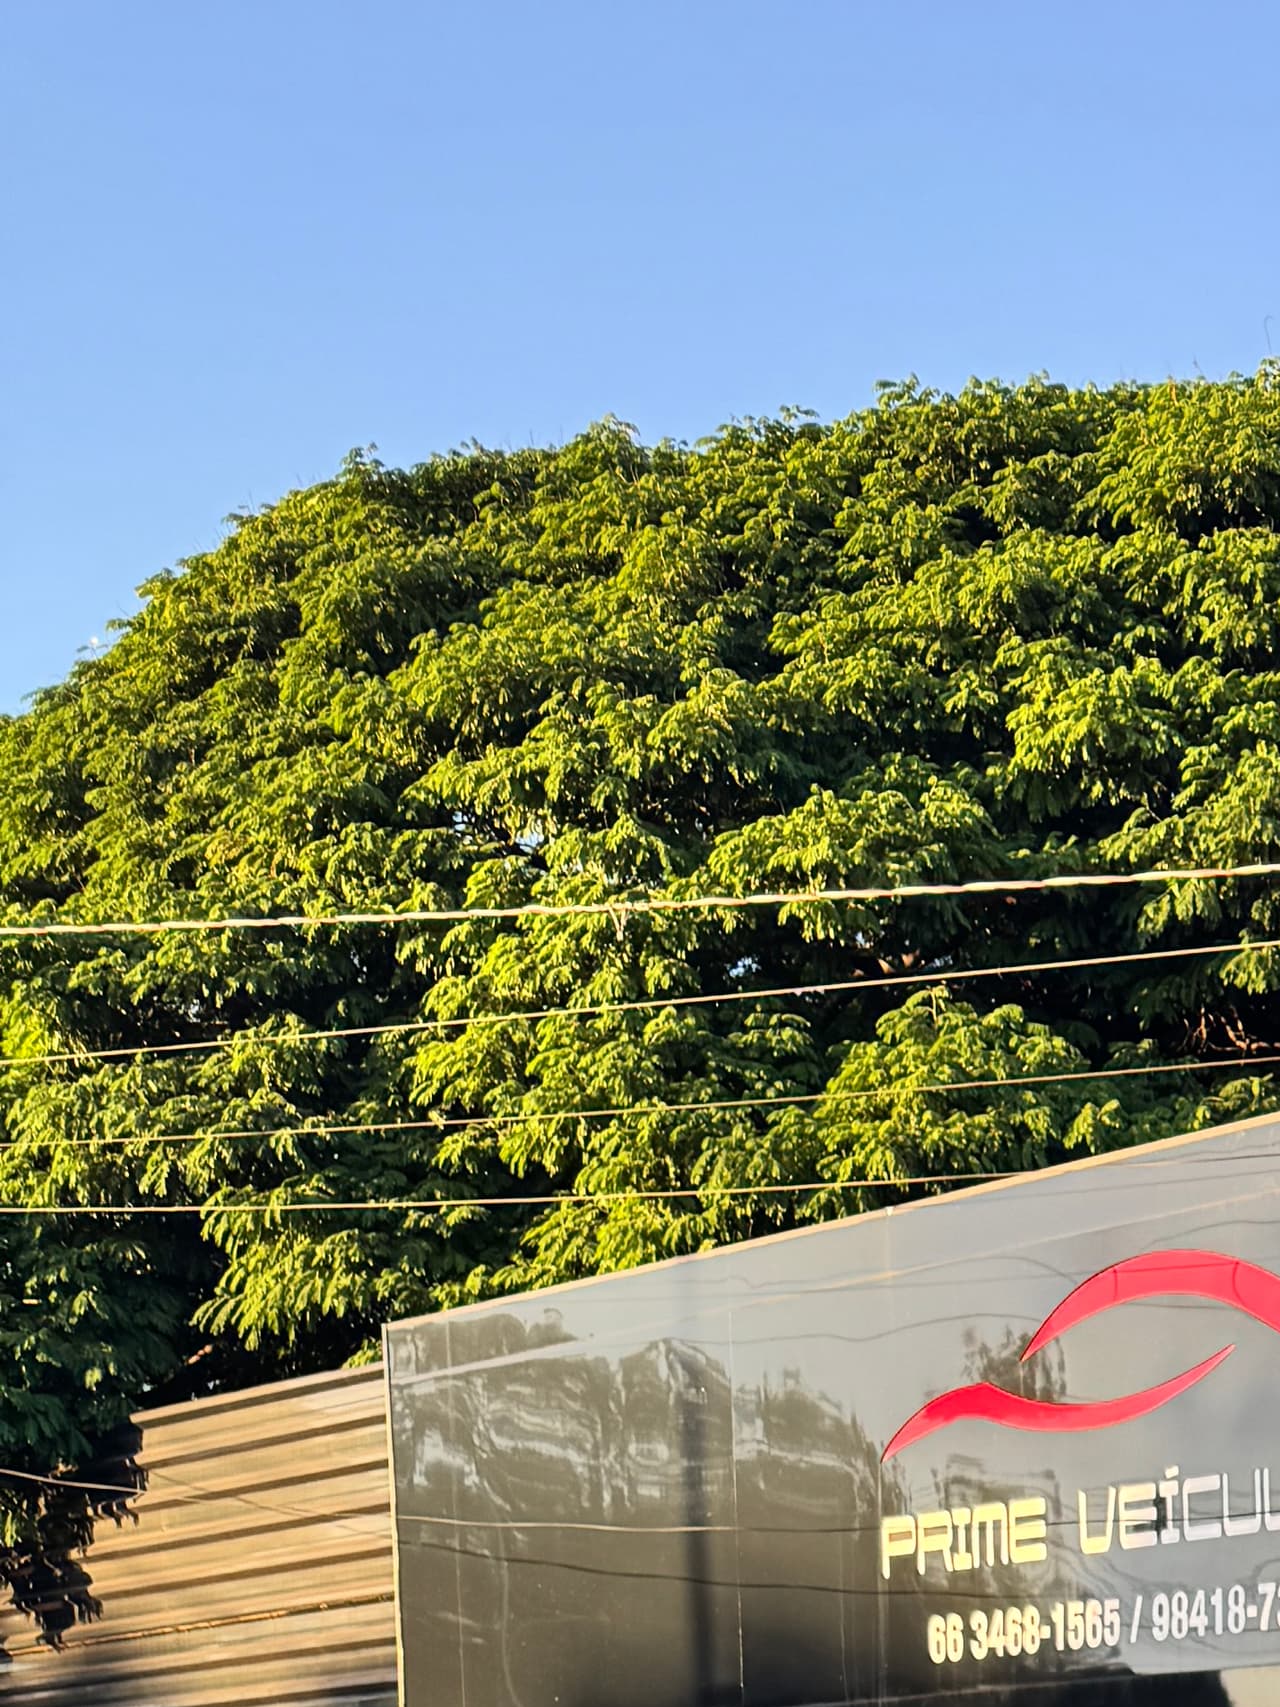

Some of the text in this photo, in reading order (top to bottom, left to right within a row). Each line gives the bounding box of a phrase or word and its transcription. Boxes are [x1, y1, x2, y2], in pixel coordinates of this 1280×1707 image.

[881, 1497, 1047, 1579] PRIME
[926, 1612, 965, 1664] 66
[969, 1598, 1122, 1657] 3468-1565
